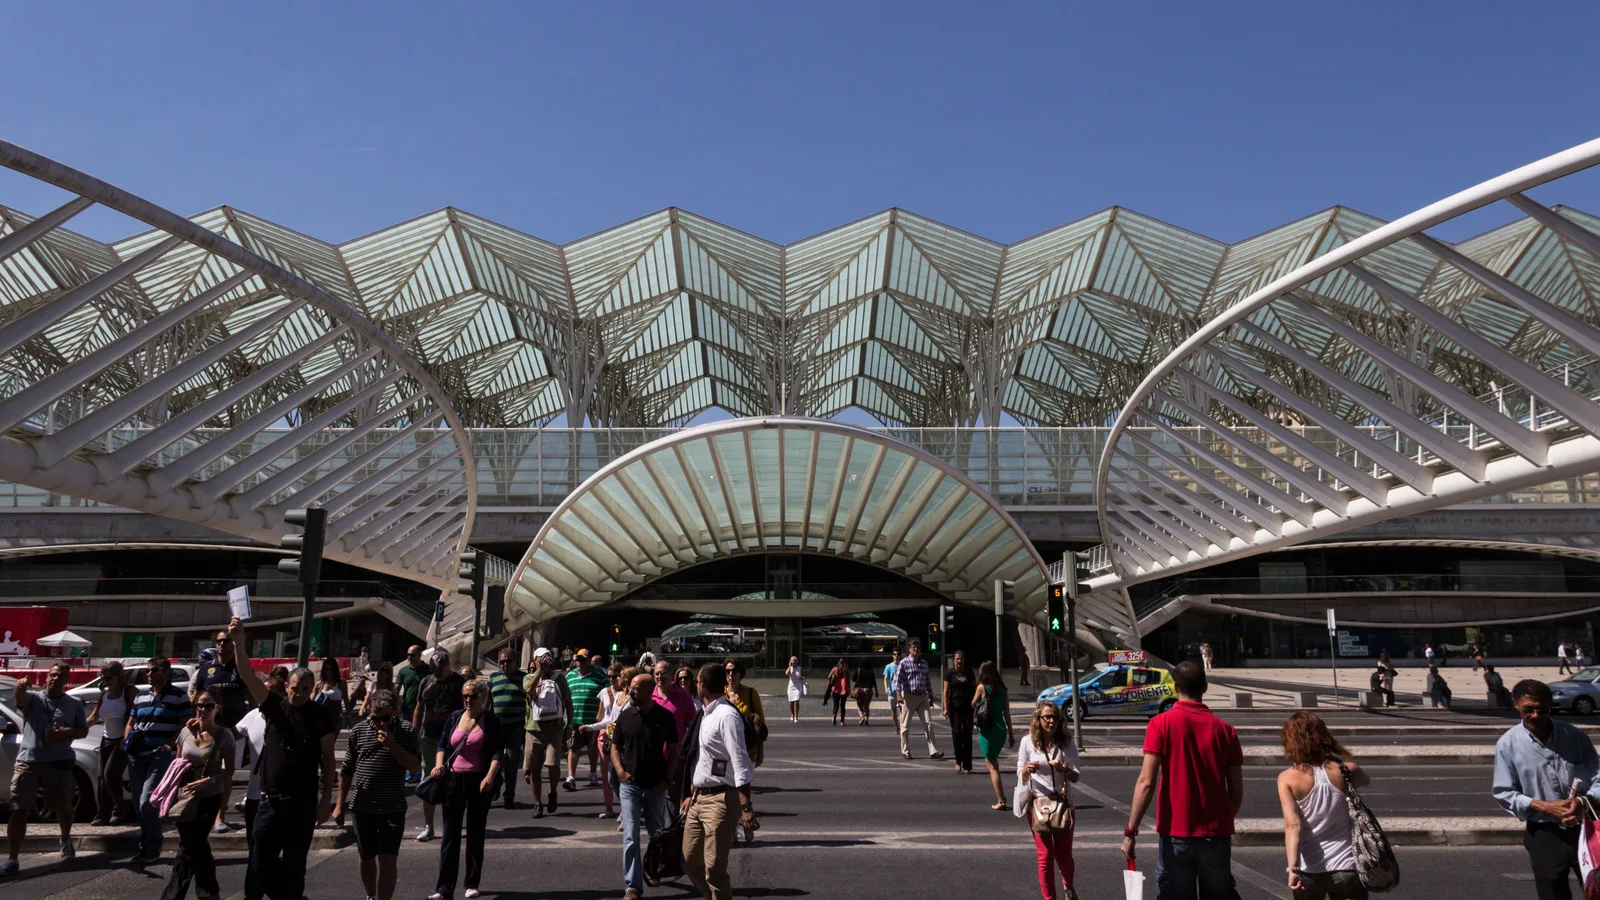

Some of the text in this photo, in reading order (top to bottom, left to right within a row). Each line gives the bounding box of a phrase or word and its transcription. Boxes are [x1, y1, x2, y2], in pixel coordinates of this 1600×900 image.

[1055, 588, 1060, 597] 6
[437, 604, 444, 619] P
[1128, 651, 1144, 661] 325€
[1085, 692, 1114, 703] GARE
[1130, 685, 1170, 699] ORIENTE
